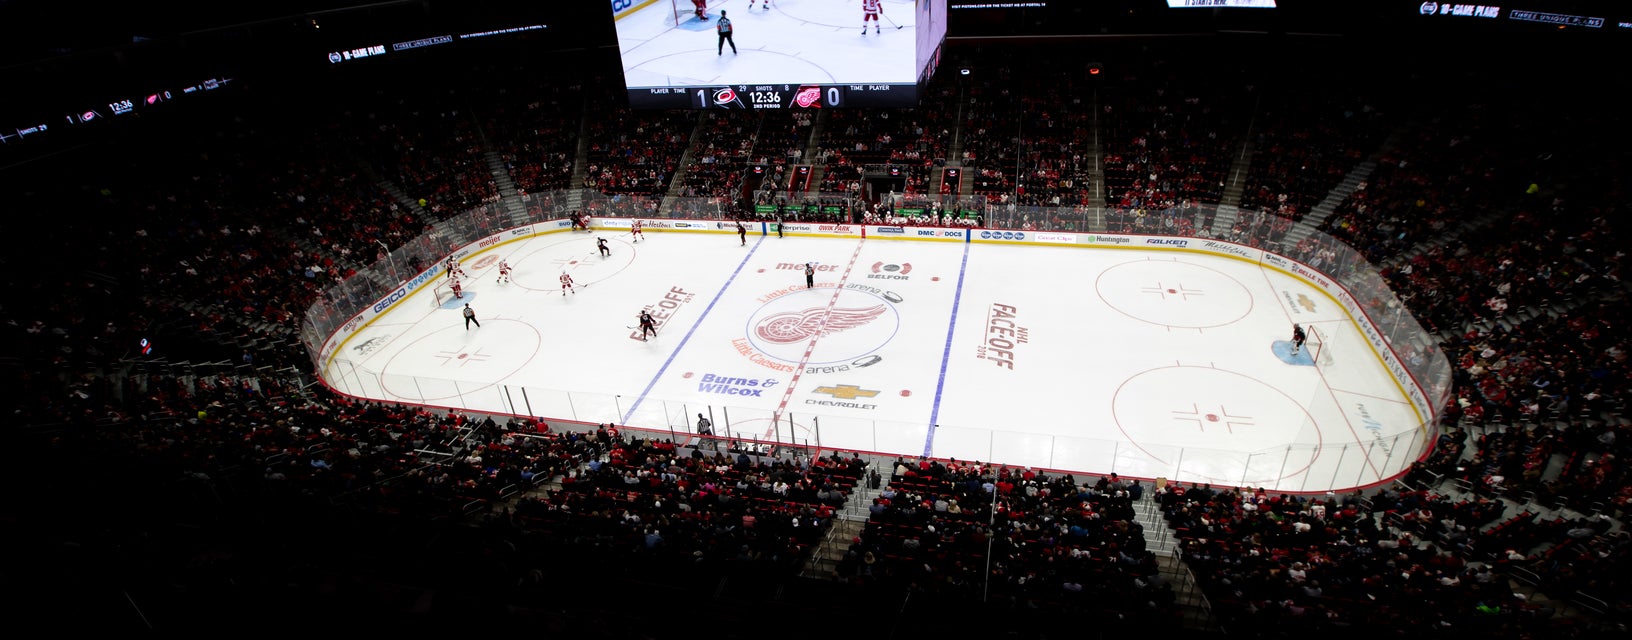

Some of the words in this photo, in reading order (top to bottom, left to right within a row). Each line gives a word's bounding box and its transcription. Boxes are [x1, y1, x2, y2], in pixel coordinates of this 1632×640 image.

[1474, 6, 1500, 18] PLANS
[368, 45, 386, 56] PLANS
[164, 90, 171, 99] 0
[697, 90, 706, 107] 1
[750, 92, 781, 103] 12:36
[828, 87, 840, 106] 0
[109, 99, 133, 112] 12:36
[479, 235, 501, 248] meijer
[1096, 235, 1130, 244] Huntington
[1146, 237, 1188, 245] FALKEN
[1299, 268, 1316, 281] BELLE
[1317, 276, 1330, 289] TIRE
[846, 283, 881, 294] arena
[373, 288, 406, 314] GEICO
[987, 303, 1017, 371] FACE-OFF
[1017, 326, 1028, 344] NHL
[732, 338, 749, 357] Little
[750, 353, 795, 373] Caesars
[806, 363, 850, 375] arena
[701, 373, 758, 388] Burns
[762, 378, 780, 388] &
[698, 383, 763, 397] Wilcox
[805, 399, 878, 410] CHEVROLET
